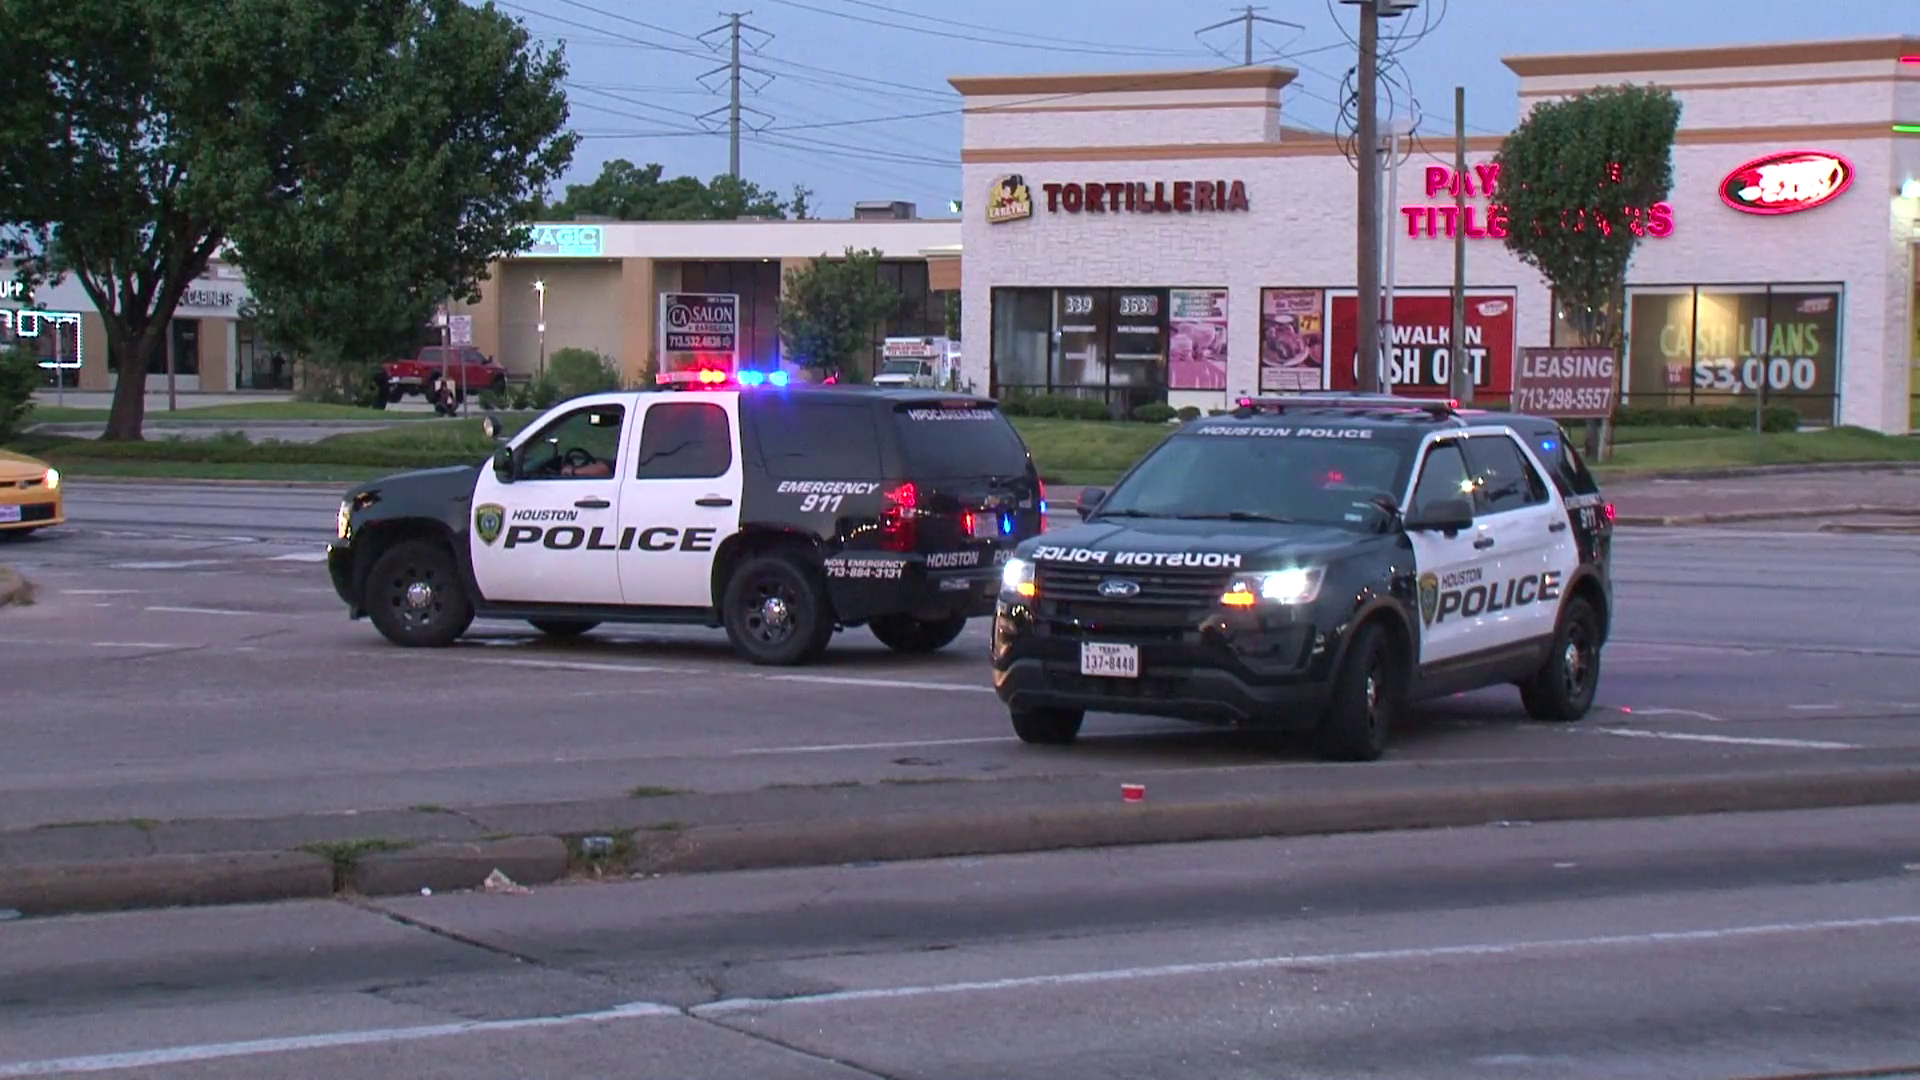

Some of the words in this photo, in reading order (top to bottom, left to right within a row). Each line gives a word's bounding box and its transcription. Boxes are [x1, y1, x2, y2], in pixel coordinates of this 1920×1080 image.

[1043, 180, 1250, 214] TORTILLERIA
[1402, 204, 1508, 239] TITLE
[187, 290, 233, 306] CABINETS
[672, 309, 688, 325] CA
[692, 305, 734, 323] SALON
[1391, 325, 1451, 345] WALK
[1660, 323, 1727, 358] CASH
[1432, 348, 1487, 385] OT
[1521, 355, 1614, 378] LEASING
[1695, 357, 1816, 394] $3,000
[1519, 387, 1611, 410] 713-298-5557
[1197, 426, 1292, 438] HOUSTON
[1296, 427, 1373, 439] POLICE
[777, 480, 880, 495] EMERGENCY
[799, 494, 844, 513] 911
[511, 509, 578, 521] HOUSTON
[1580, 507, 1597, 529] 911
[503, 525, 718, 552] POLICE
[823, 558, 846, 567] NON
[847, 559, 907, 568] EMERGENCY
[926, 551, 980, 568] HOUSTON
[1440, 567, 1483, 588] HOUSTON
[1435, 570, 1562, 624] POLICE
